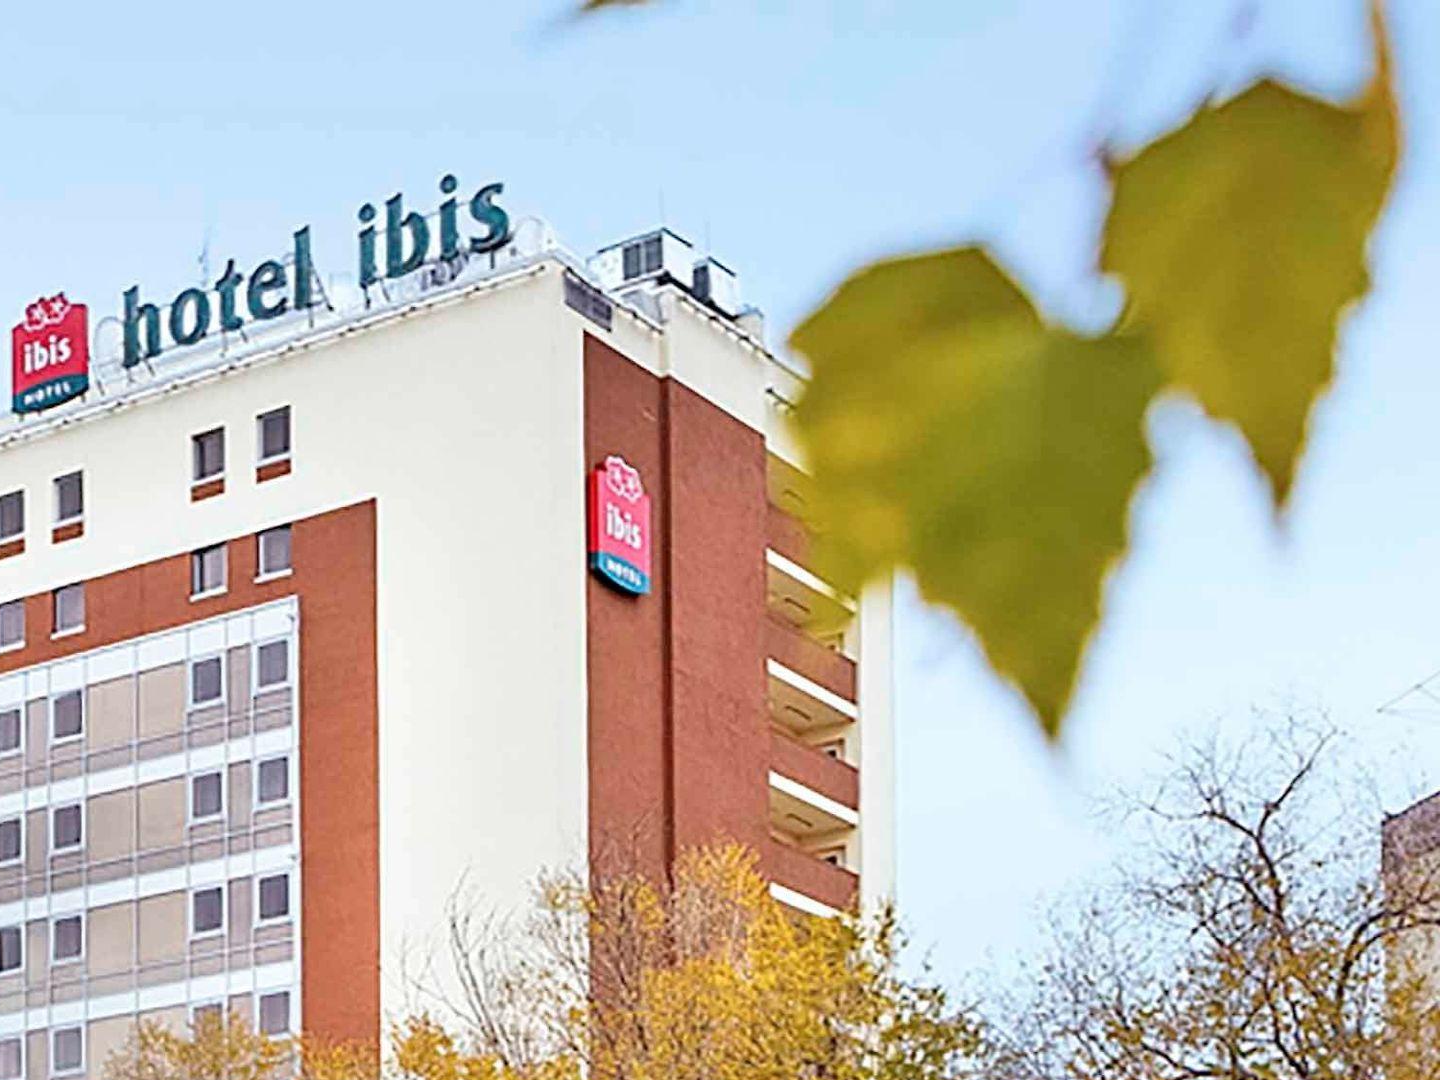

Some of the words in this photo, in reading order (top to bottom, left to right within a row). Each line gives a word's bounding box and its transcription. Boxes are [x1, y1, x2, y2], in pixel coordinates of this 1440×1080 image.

[122, 225, 313, 368] hotel
[358, 174, 510, 288] ibis
[23, 334, 72, 374] ibis
[606, 502, 642, 550] ibis
